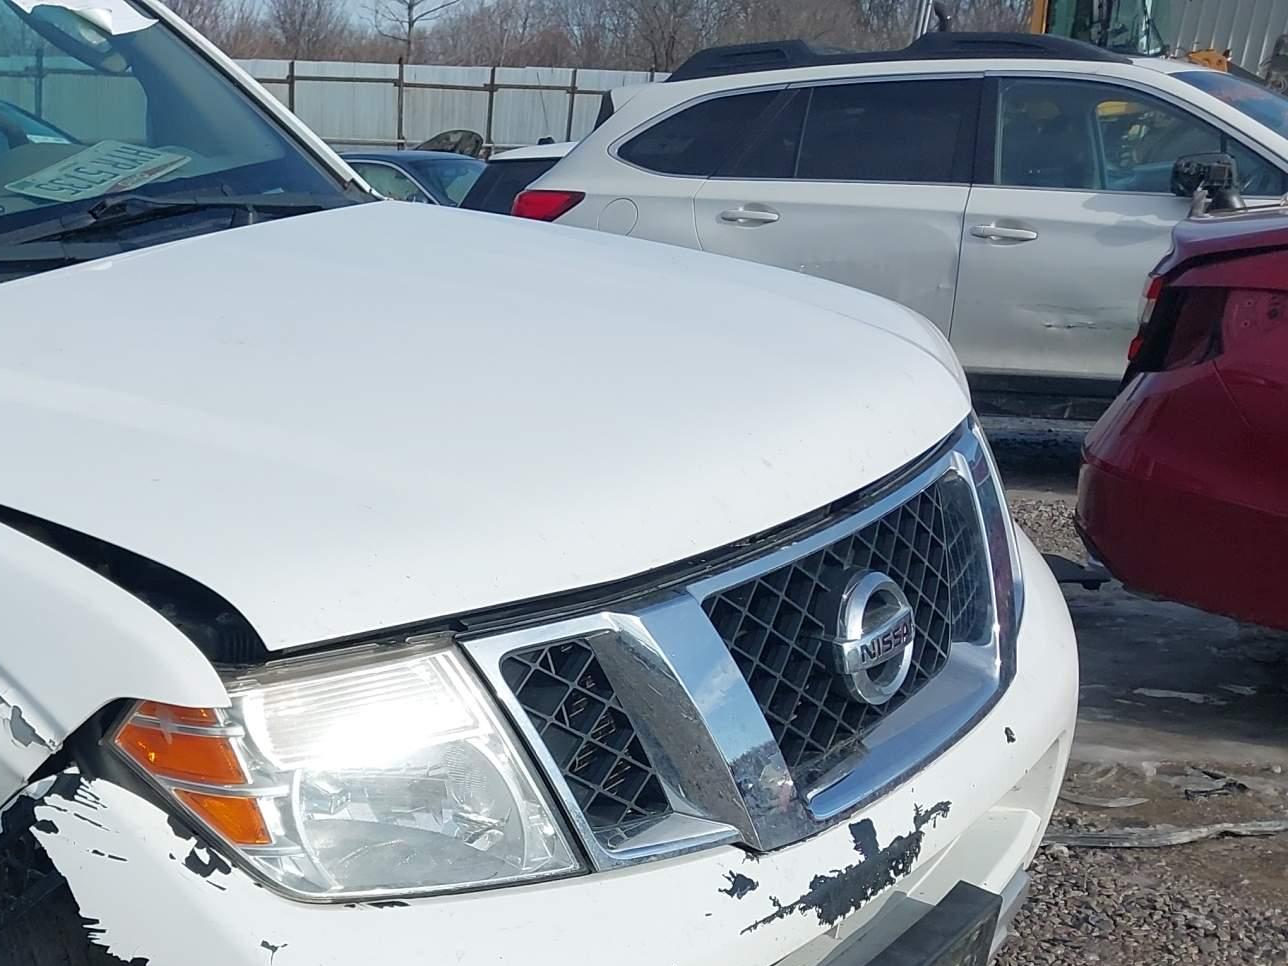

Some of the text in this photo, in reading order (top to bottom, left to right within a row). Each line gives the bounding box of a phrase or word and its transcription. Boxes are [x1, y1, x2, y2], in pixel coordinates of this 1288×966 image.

[87, 145, 163, 170] HYR
[35, 166, 122, 196] 5735
[859, 620, 910, 665] NISSA
